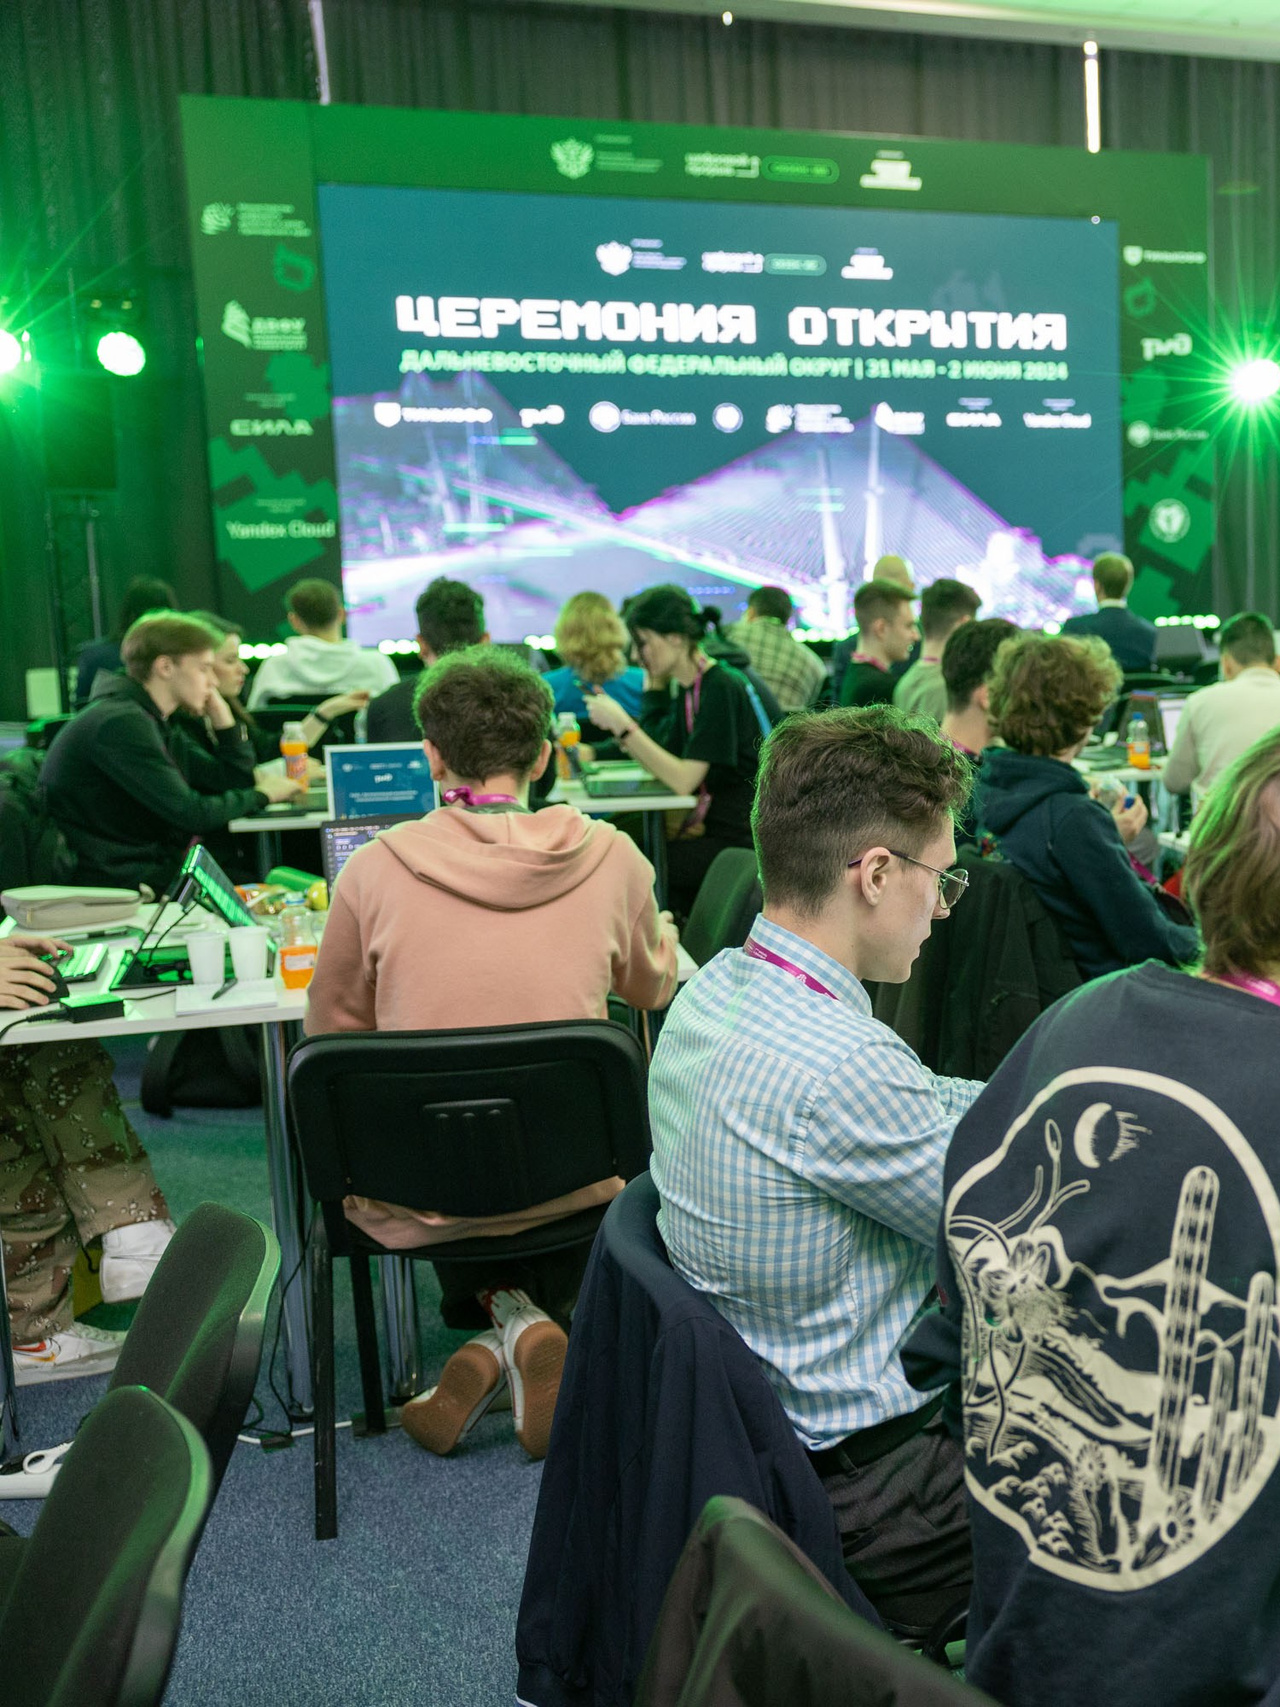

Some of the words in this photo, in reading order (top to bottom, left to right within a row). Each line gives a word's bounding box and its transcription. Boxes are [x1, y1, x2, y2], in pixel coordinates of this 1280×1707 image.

[396, 295, 757, 344] ЦЕРЕМОНИЯ
[788, 306, 1067, 351] ОТКРЫТИЯ
[399, 348, 627, 374] ДАЛЬНЕВОСТОЧНЫЙ
[627, 351, 789, 378] ФЕДЕРАЛЬНЫЙ
[789, 356, 853, 377] ОКРУГ
[892, 358, 936, 379] МАЯ
[962, 359, 1022, 381] ИЮНЯ
[226, 520, 287, 539] Yandex
[287, 519, 336, 538] Cloud
